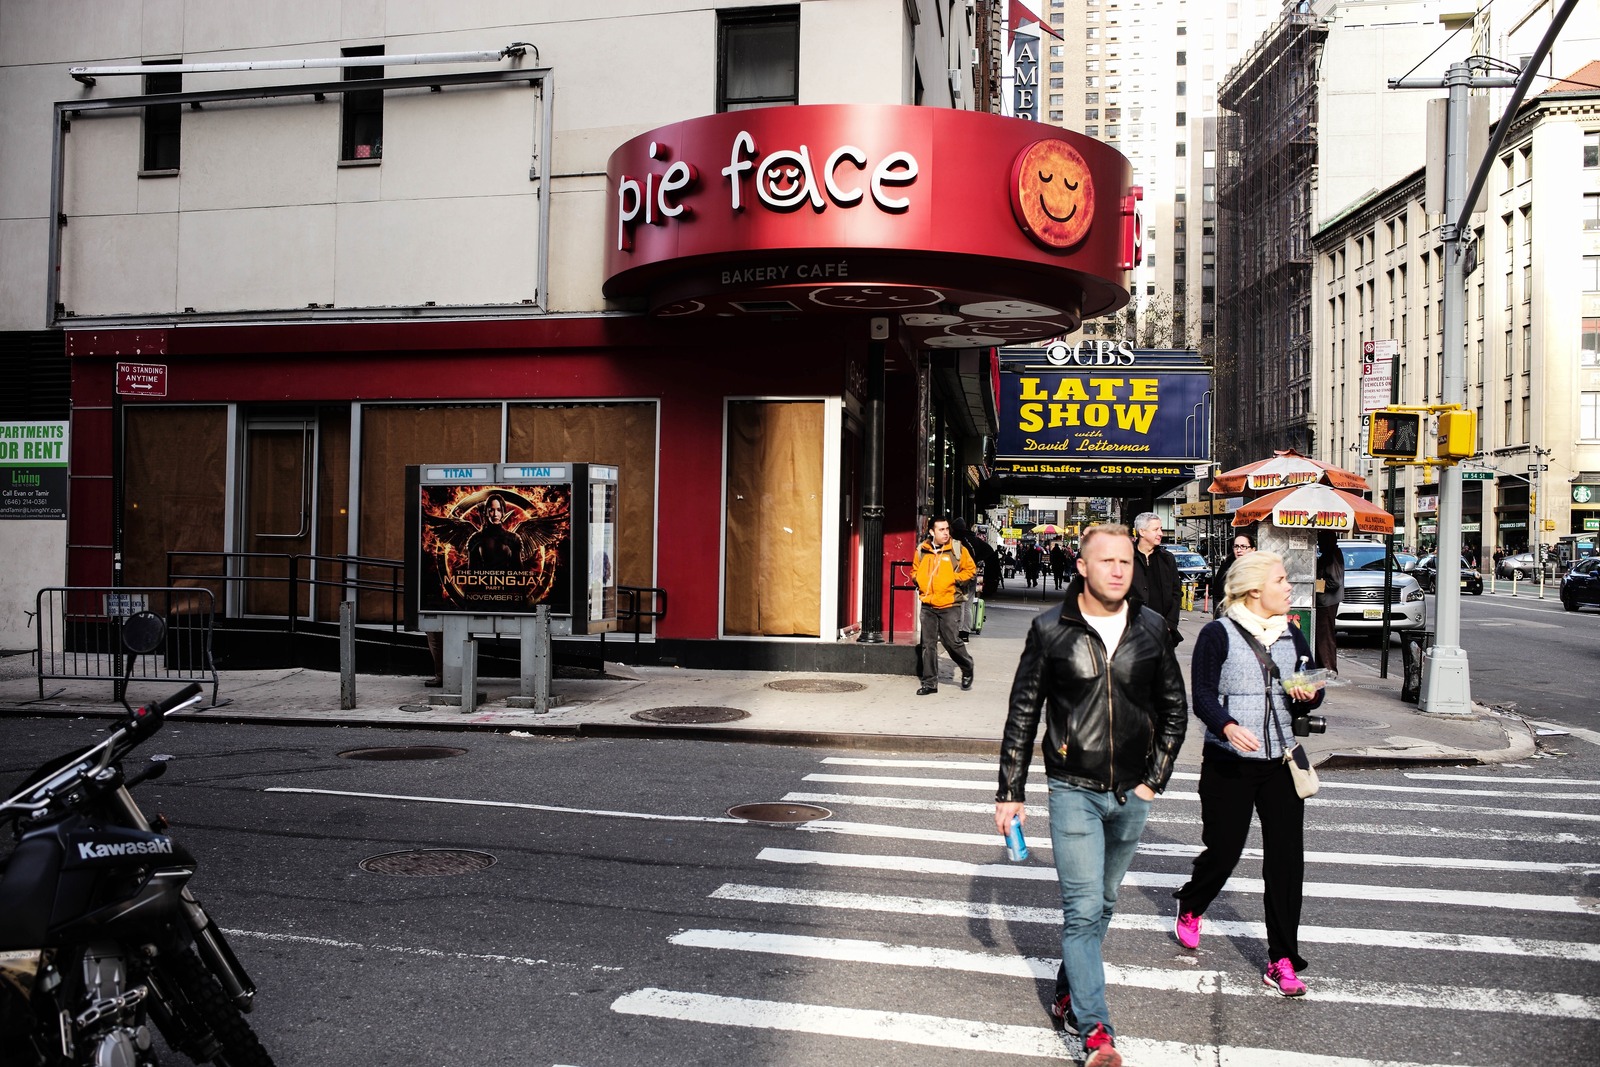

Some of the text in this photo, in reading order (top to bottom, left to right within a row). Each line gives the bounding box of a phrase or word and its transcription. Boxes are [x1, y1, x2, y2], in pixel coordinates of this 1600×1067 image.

[617, 130, 919, 252] pie face
[721, 259, 849, 285] BAKERY CAFÉ
[1074, 339, 1135, 366] CBS
[1365, 365, 1371, 374] 3
[1019, 377, 1159, 401] LATE
[1019, 403, 1158, 434] SHOW
[1364, 416, 1369, 425] 6
[0, 426, 63, 438] PARTMENTS
[0, 442, 63, 459] OR RENT
[1023, 438, 1150, 452] David Letterman
[443, 469, 472, 478] TITAN
[520, 467, 550, 477] TITAN
[1012, 464, 1039, 473] Paul
[1040, 464, 1082, 473] Shaffer
[1100, 466, 1122, 474] CBS
[1124, 466, 1180, 475] Orchestra
[12, 470, 40, 486] Living
[444, 575, 546, 586] MOCKINGJAY
[78, 838, 173, 860] Kawasaki
